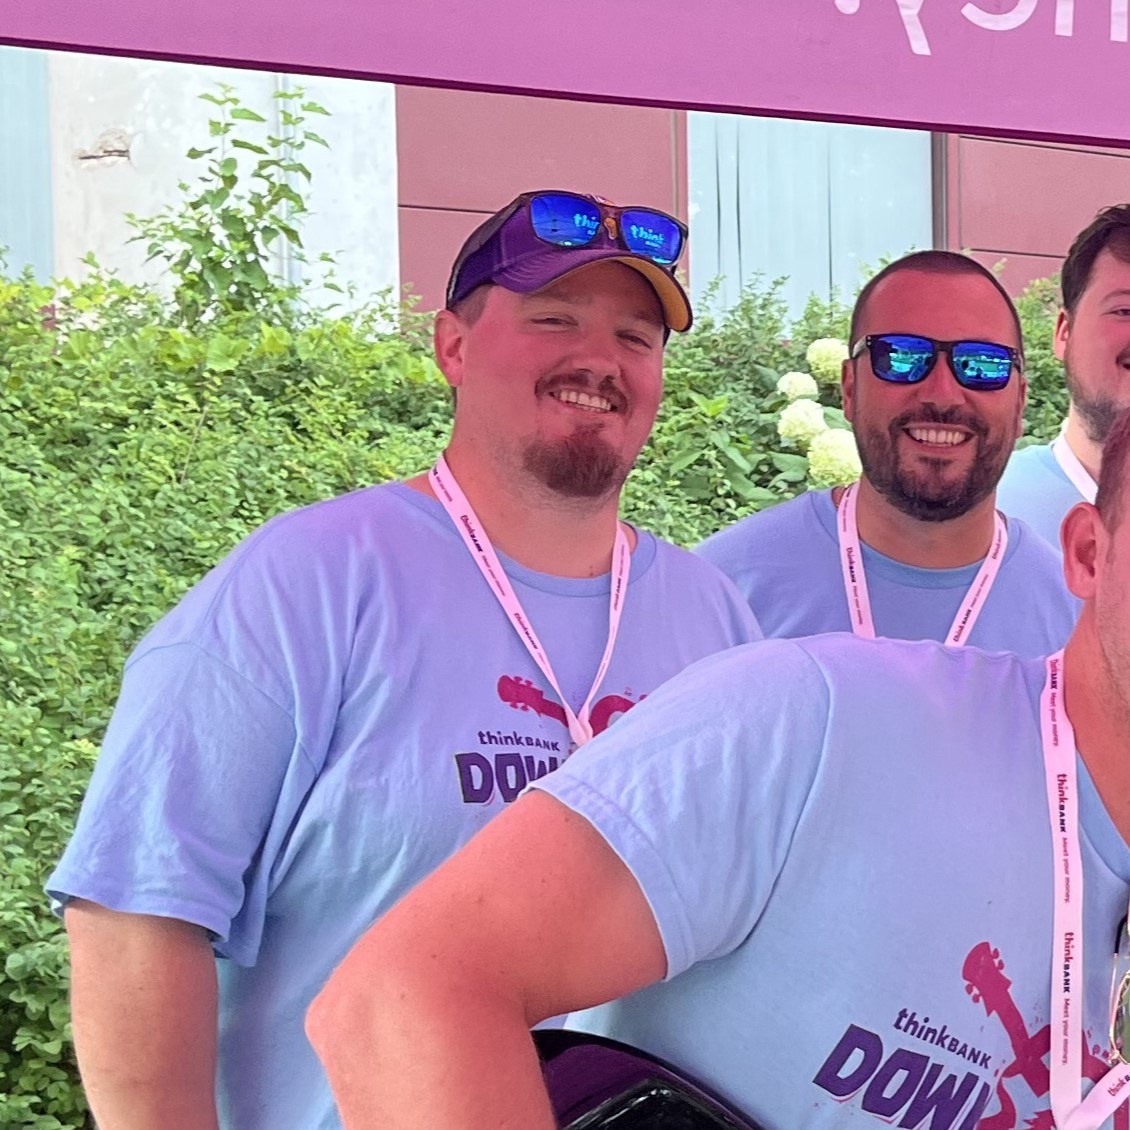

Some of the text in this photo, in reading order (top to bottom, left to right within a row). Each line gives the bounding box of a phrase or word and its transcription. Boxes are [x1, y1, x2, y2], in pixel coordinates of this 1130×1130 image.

[478, 730, 561, 752] thinkBANK
[455, 752, 566, 804] DOW
[1056, 772, 1069, 833] thinkBANK
[1062, 931, 1075, 994] thinkBANK
[893, 1008, 992, 1070] thinkBANK
